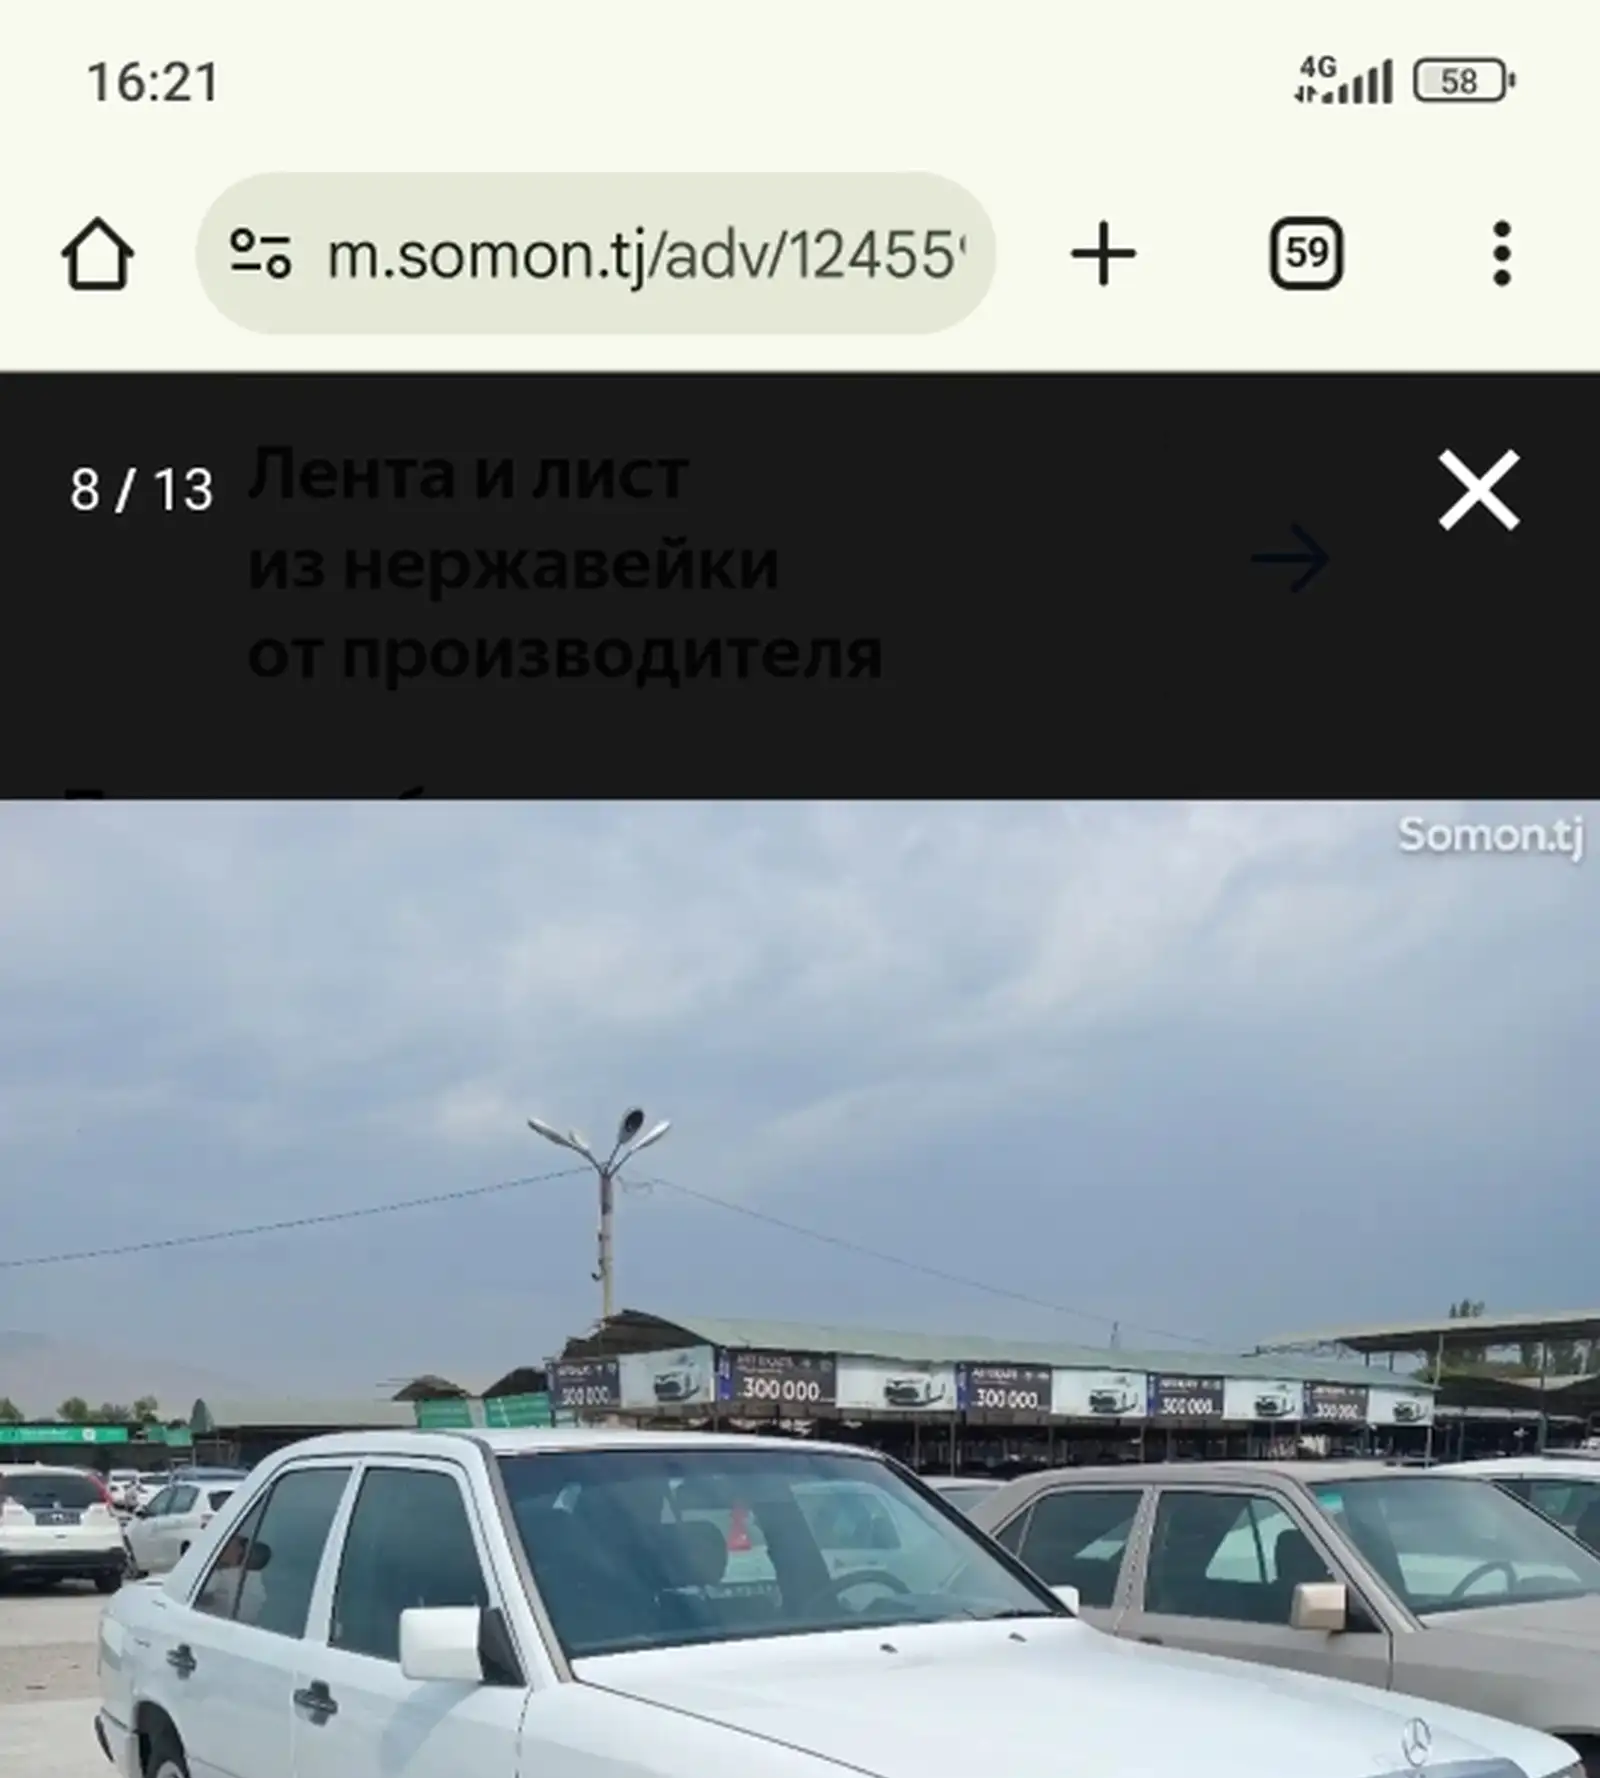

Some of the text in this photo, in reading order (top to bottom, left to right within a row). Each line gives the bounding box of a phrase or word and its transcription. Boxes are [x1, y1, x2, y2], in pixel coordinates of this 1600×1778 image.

[87, 61, 218, 102] 16:21
[1300, 55, 1337, 78] 4G
[1442, 67, 1477, 94] 58
[328, 225, 968, 293] m.somon.tj/adv/12455
[1286, 238, 1328, 267] 59
[70, 467, 213, 514] 8 / 13
[248, 446, 691, 499] Лента и лист
[250, 536, 779, 602] из нержавейки
[248, 637, 882, 692] от производителя
[743, 1377, 821, 1402] 300 000
[976, 1388, 1038, 1410] 300 000
